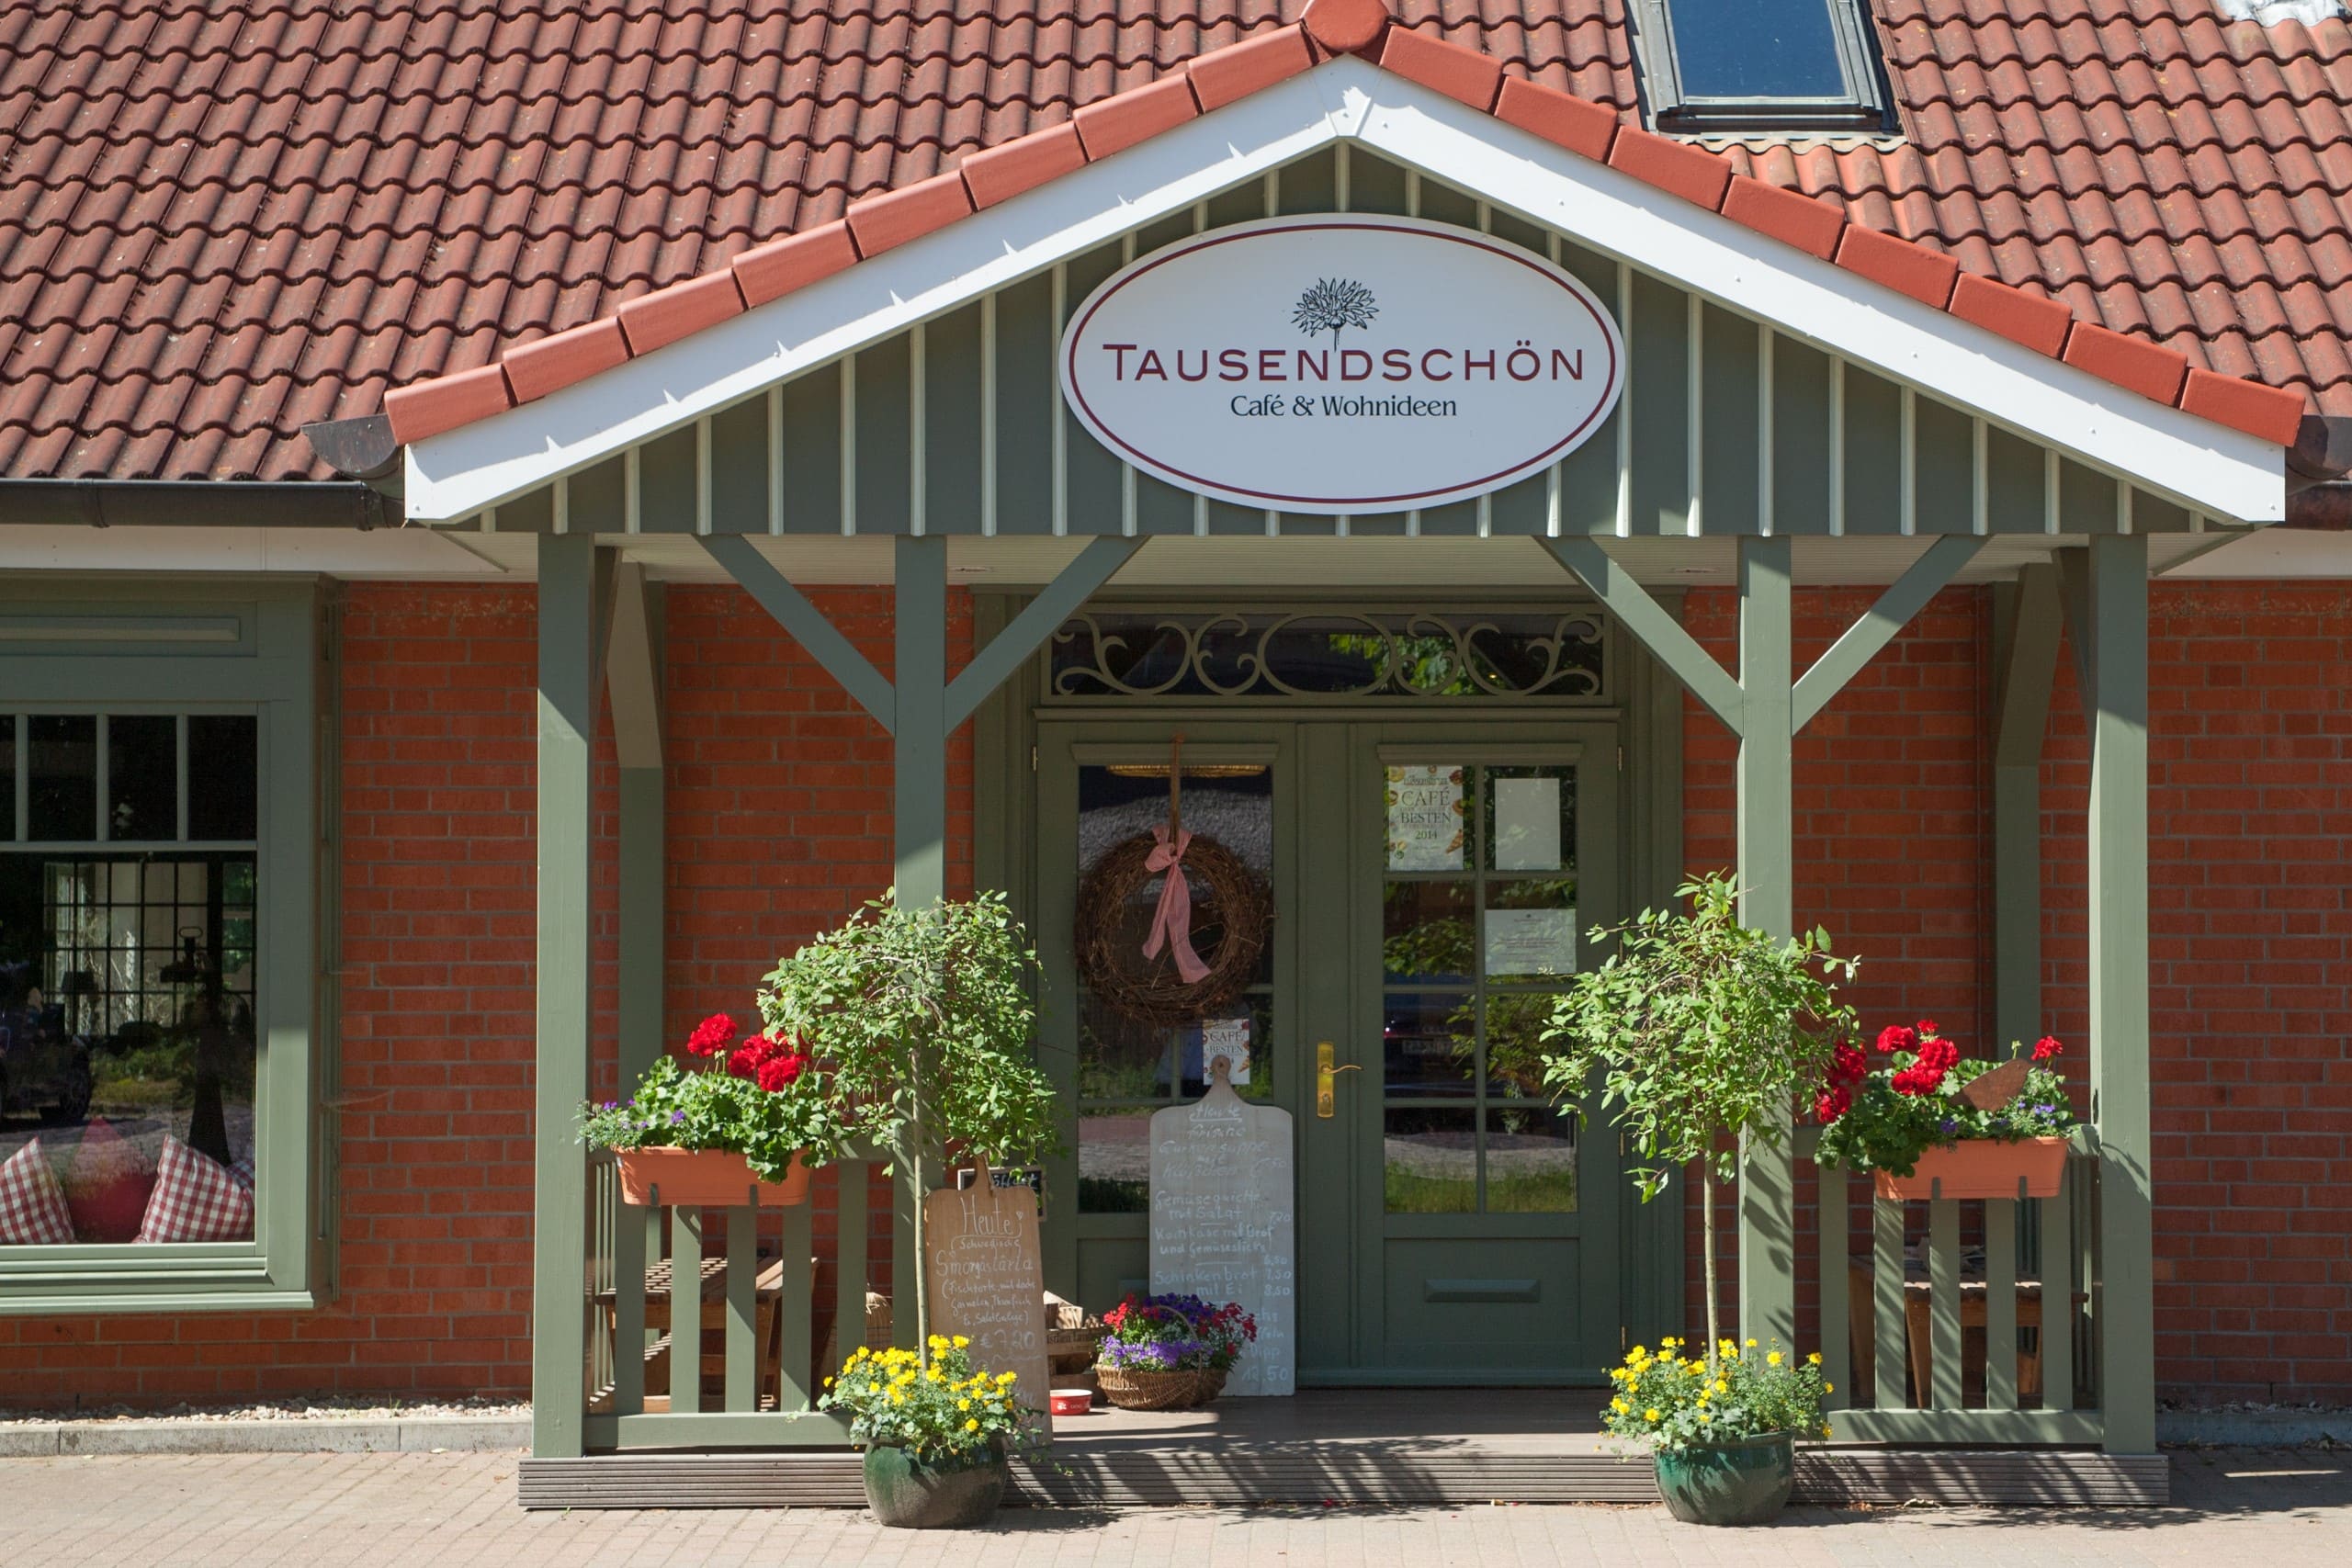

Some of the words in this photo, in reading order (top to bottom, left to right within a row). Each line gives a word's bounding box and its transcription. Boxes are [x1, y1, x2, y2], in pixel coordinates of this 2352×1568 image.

[1102, 339, 1584, 383] TAUSENDSCHÖN
[1229, 392, 1285, 418] Café
[1292, 394, 1316, 418] &
[1322, 393, 1458, 418] Wohnideen
[1401, 786, 1451, 807] CAFÉ
[1401, 812, 1452, 824] BESTEN
[1415, 829, 1438, 840] 2014
[960, 1193, 1013, 1236] Heute
[1159, 1243, 1186, 1255] und
